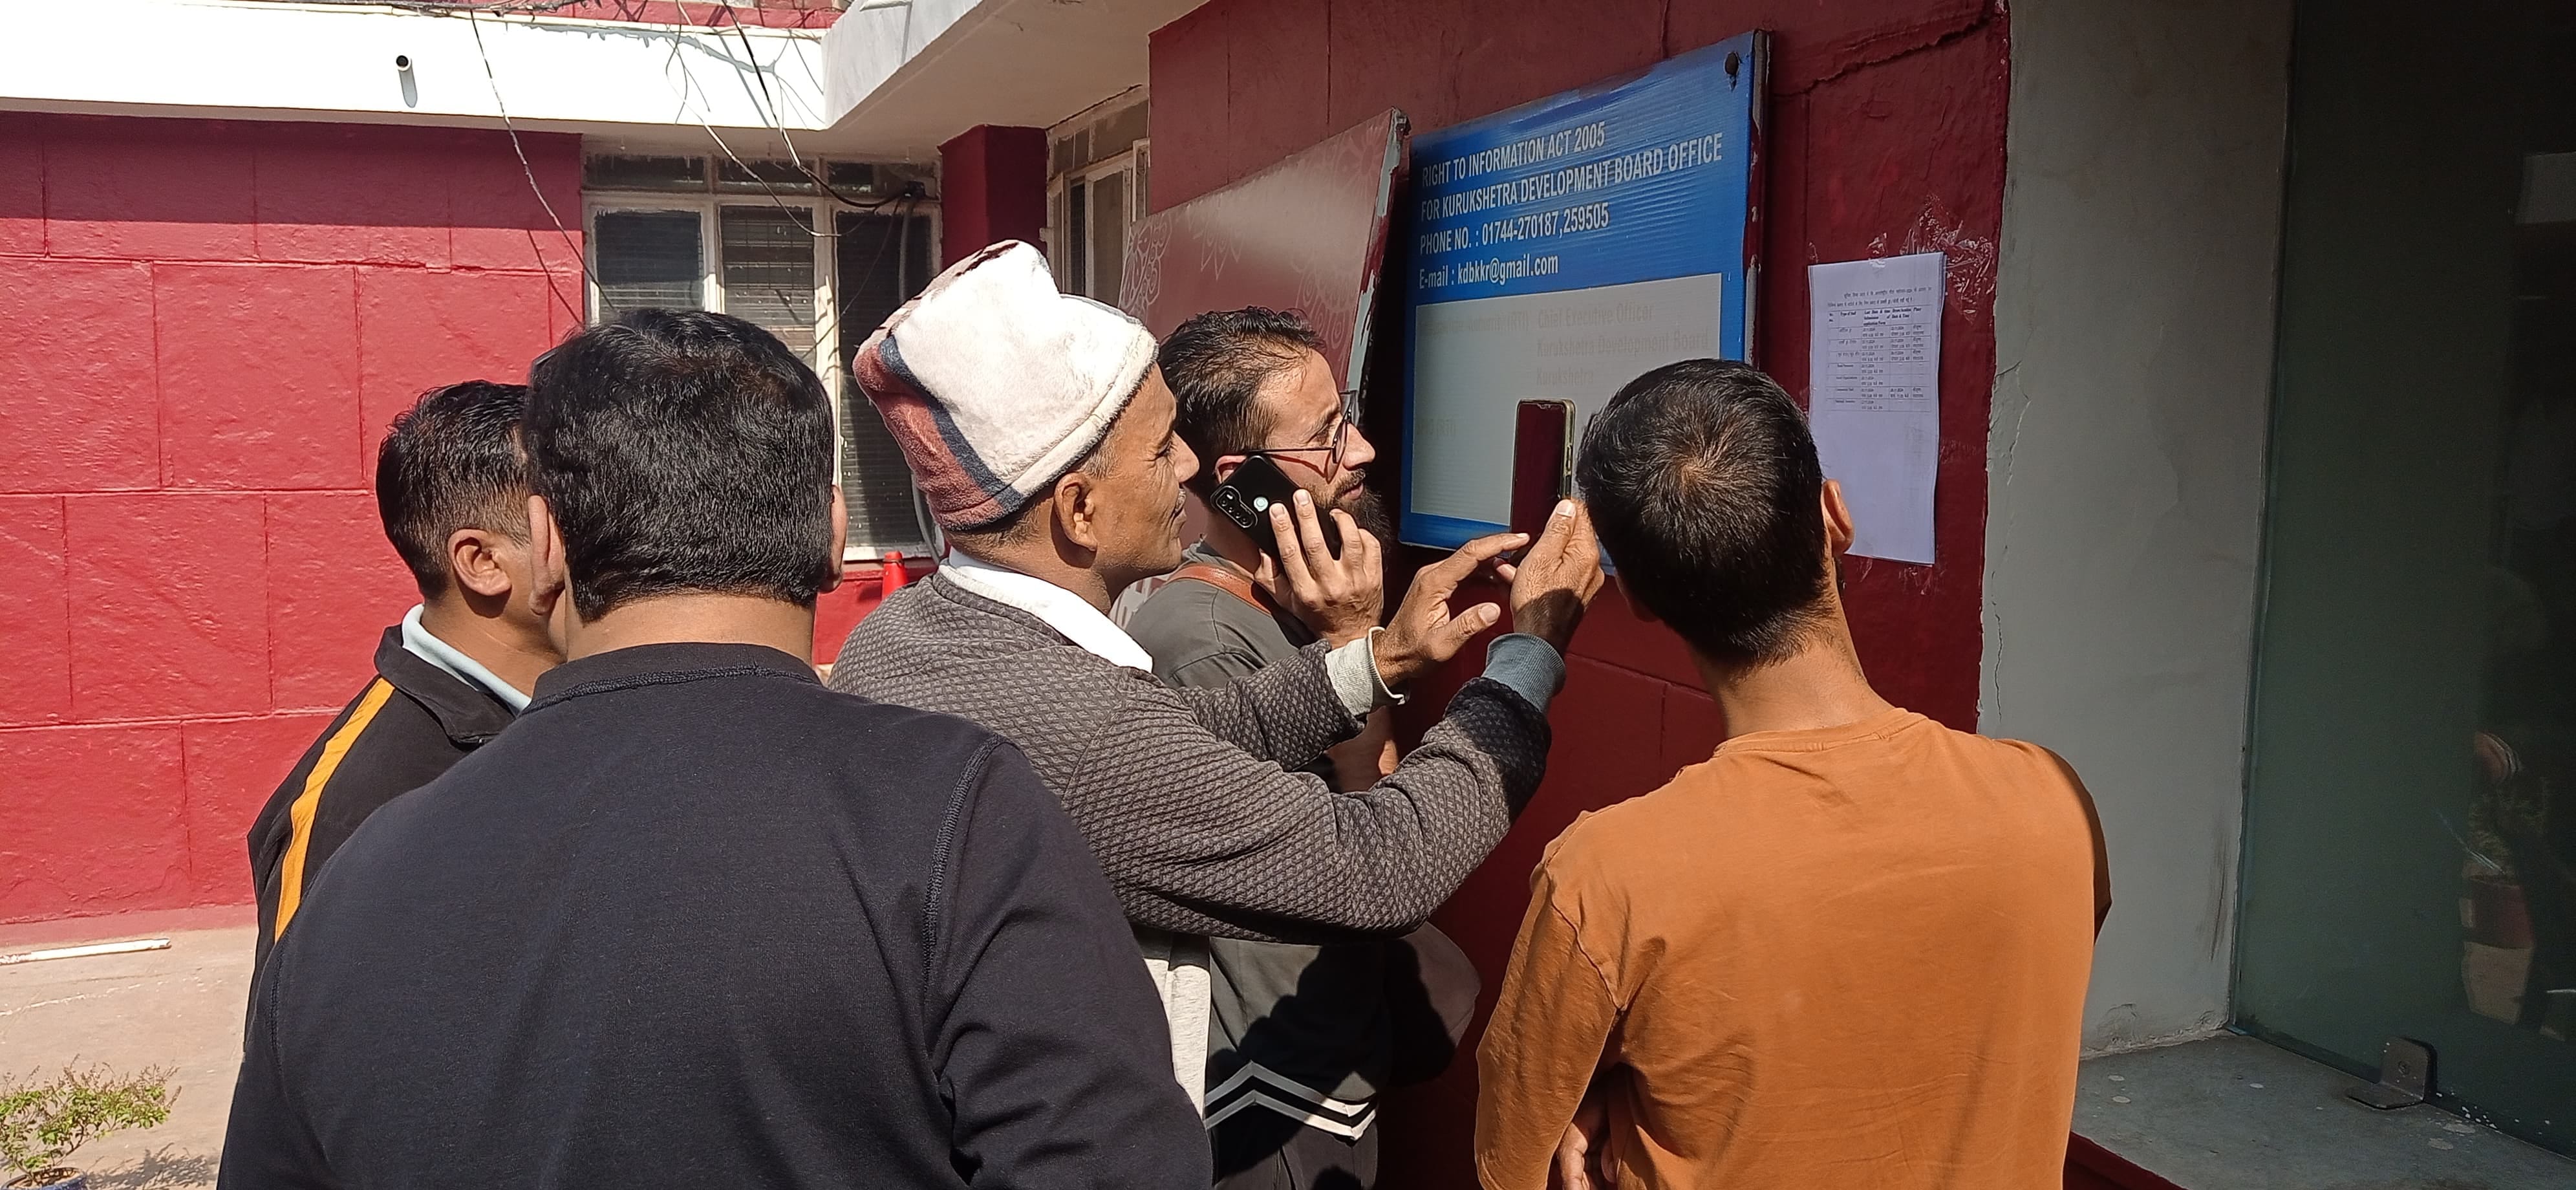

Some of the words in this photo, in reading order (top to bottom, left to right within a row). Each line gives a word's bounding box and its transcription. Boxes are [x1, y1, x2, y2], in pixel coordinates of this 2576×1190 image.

[1421, 198, 1440, 222] FOR
[1442, 181, 1518, 218] KURUKSHETRA
[1520, 160, 1611, 203] DEVELOPMENT
[1614, 148, 1664, 184] BOARD
[1668, 133, 1723, 172] OFFICE
[1422, 160, 1451, 187] RIGHT
[1454, 157, 1466, 181] TO
[1468, 136, 1545, 177] INFORMATION
[1547, 129, 1572, 159] ACT
[1574, 121, 1605, 153] 2005
[1420, 229, 1452, 255] PHONE
[1454, 226, 1472, 250] NO.
[1482, 202, 1609, 246] 01744-270187,259505
[1419, 265, 1448, 289] E-mail
[1457, 253, 1559, 285] kdbkkr@gmail.com
[1566, 306, 1614, 326] Executive
[1617, 301, 1655, 323] Officer
